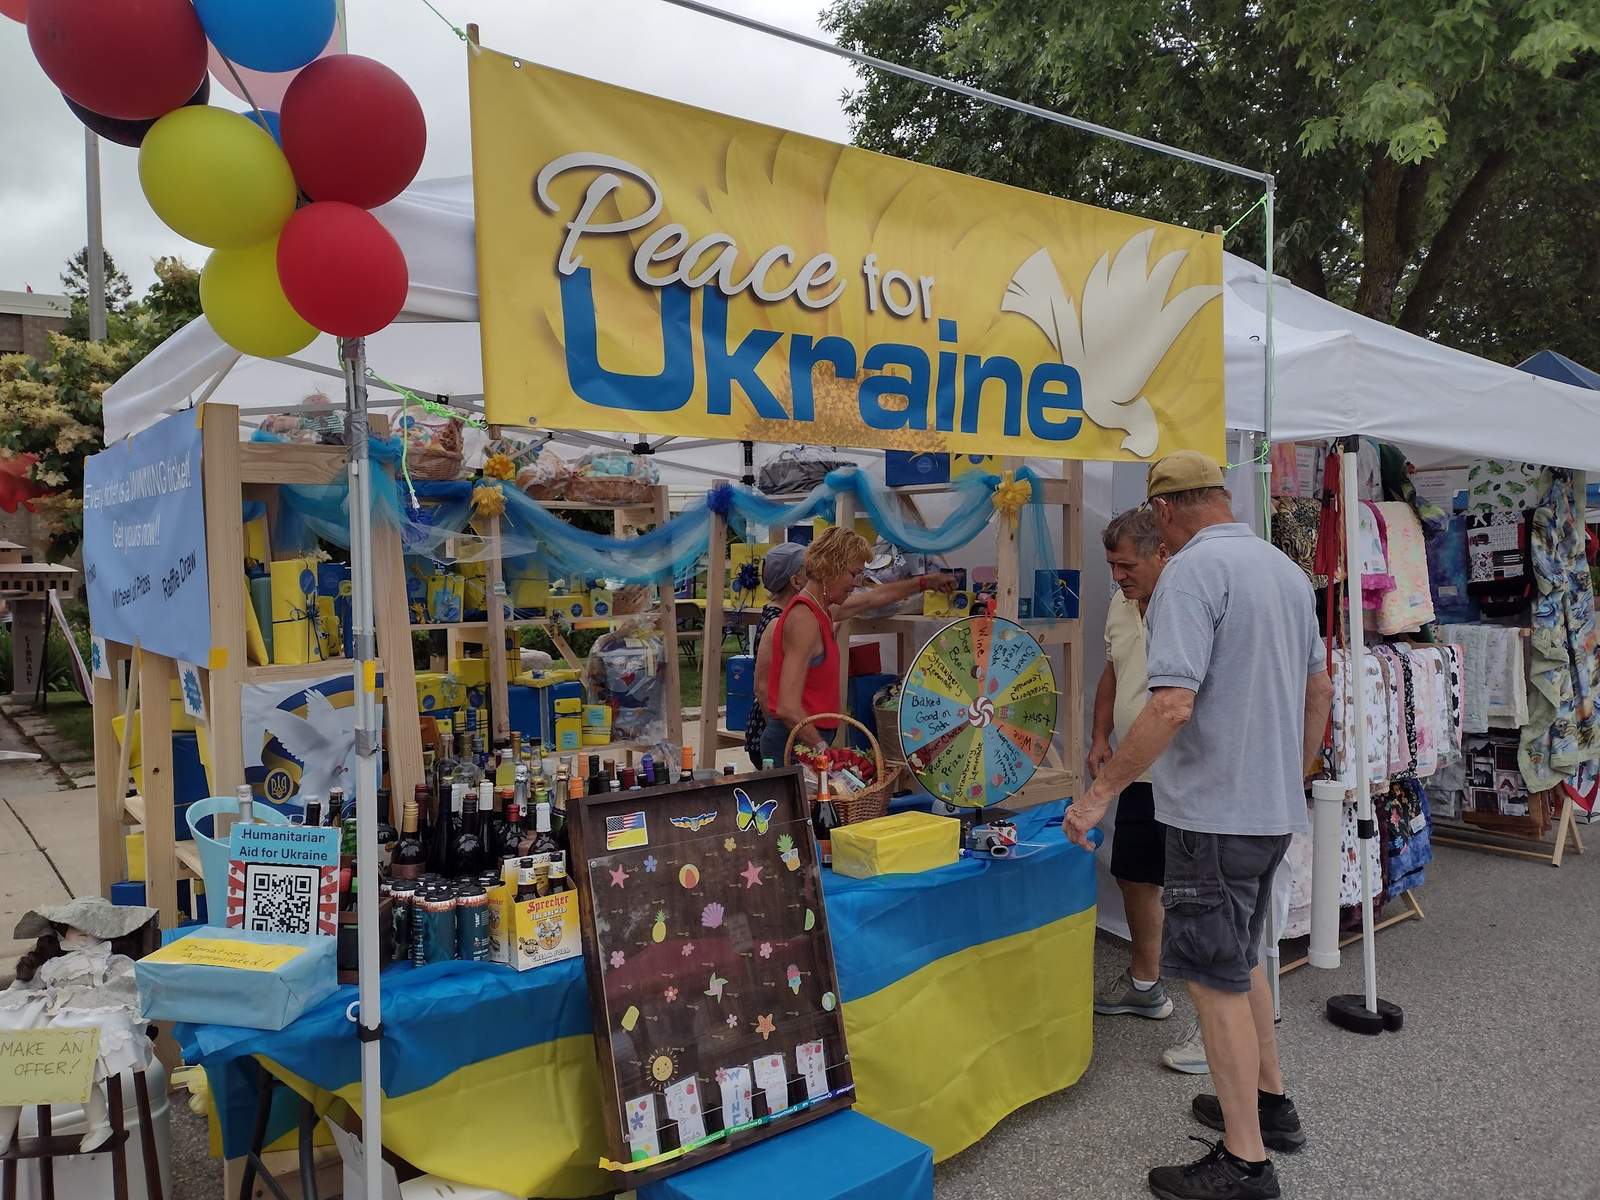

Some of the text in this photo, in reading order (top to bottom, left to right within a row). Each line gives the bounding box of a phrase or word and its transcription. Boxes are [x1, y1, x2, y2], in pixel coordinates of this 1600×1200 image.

[534, 151, 934, 320] Peace for
[558, 266, 1083, 441] Ukraine
[83, 483, 104, 513] Every
[129, 463, 167, 500] WINNING
[112, 519, 124, 548] Get
[125, 524, 142, 556] yours
[161, 549, 197, 603] Raffle Draw
[111, 583, 132, 609] Wheel
[24, 635, 32, 684] LIBRARY
[912, 695, 941, 708] Baked
[916, 710, 939, 724] Good
[243, 829, 325, 843] Humanitarian
[239, 846, 327, 861] Aid for Ukraine
[526, 895, 569, 914] Sprecher
[184, 944, 249, 958] Donations
[0, 1039, 85, 1057] MAKE AN
[14, 1058, 81, 1077] OFFER!
